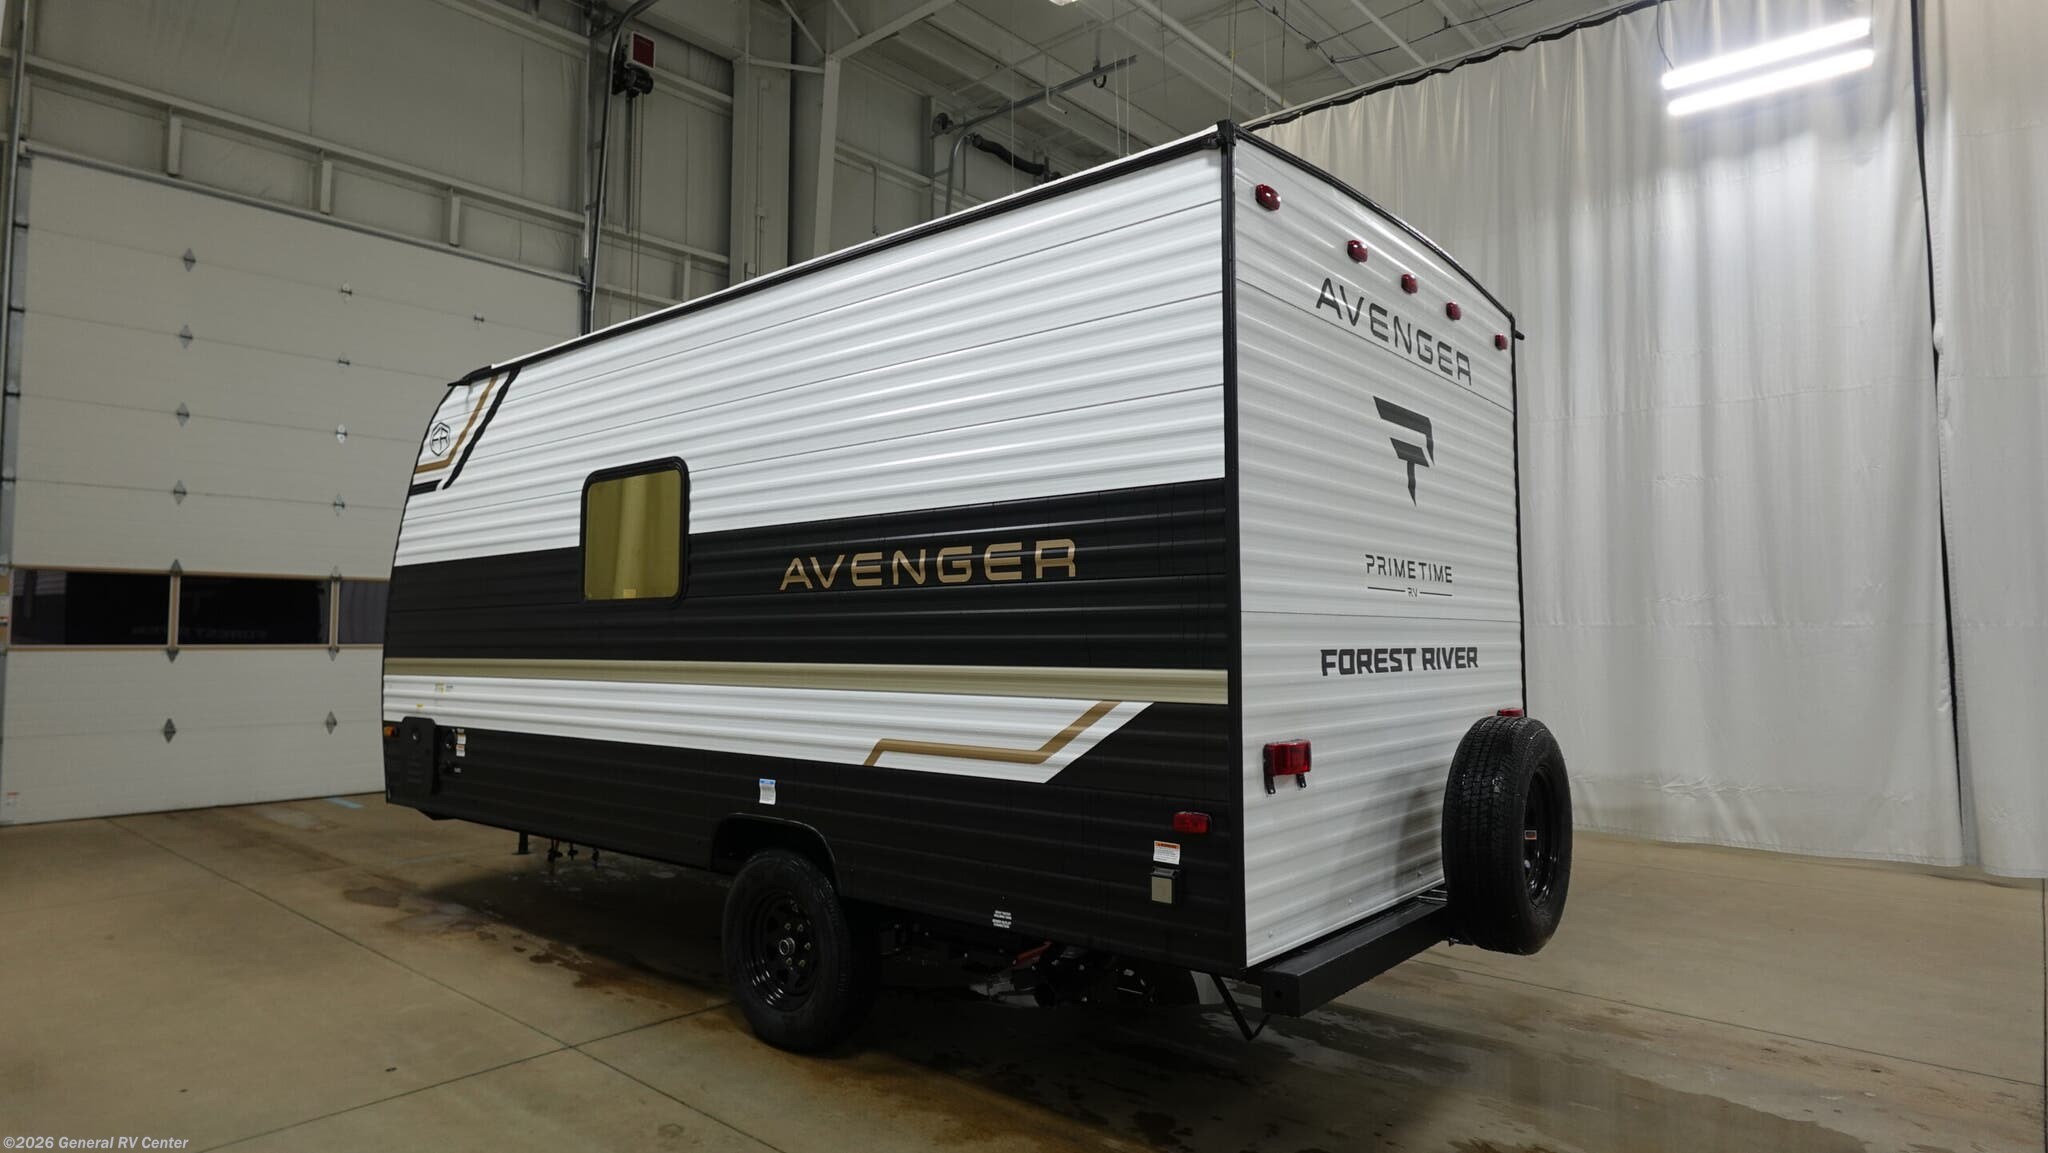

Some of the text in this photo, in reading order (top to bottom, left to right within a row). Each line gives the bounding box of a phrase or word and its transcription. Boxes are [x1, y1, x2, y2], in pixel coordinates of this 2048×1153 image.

[1316, 277, 1472, 386] AVENGER
[779, 539, 1077, 591] AVENGER
[1320, 646, 1479, 677] FOREST RIVER
